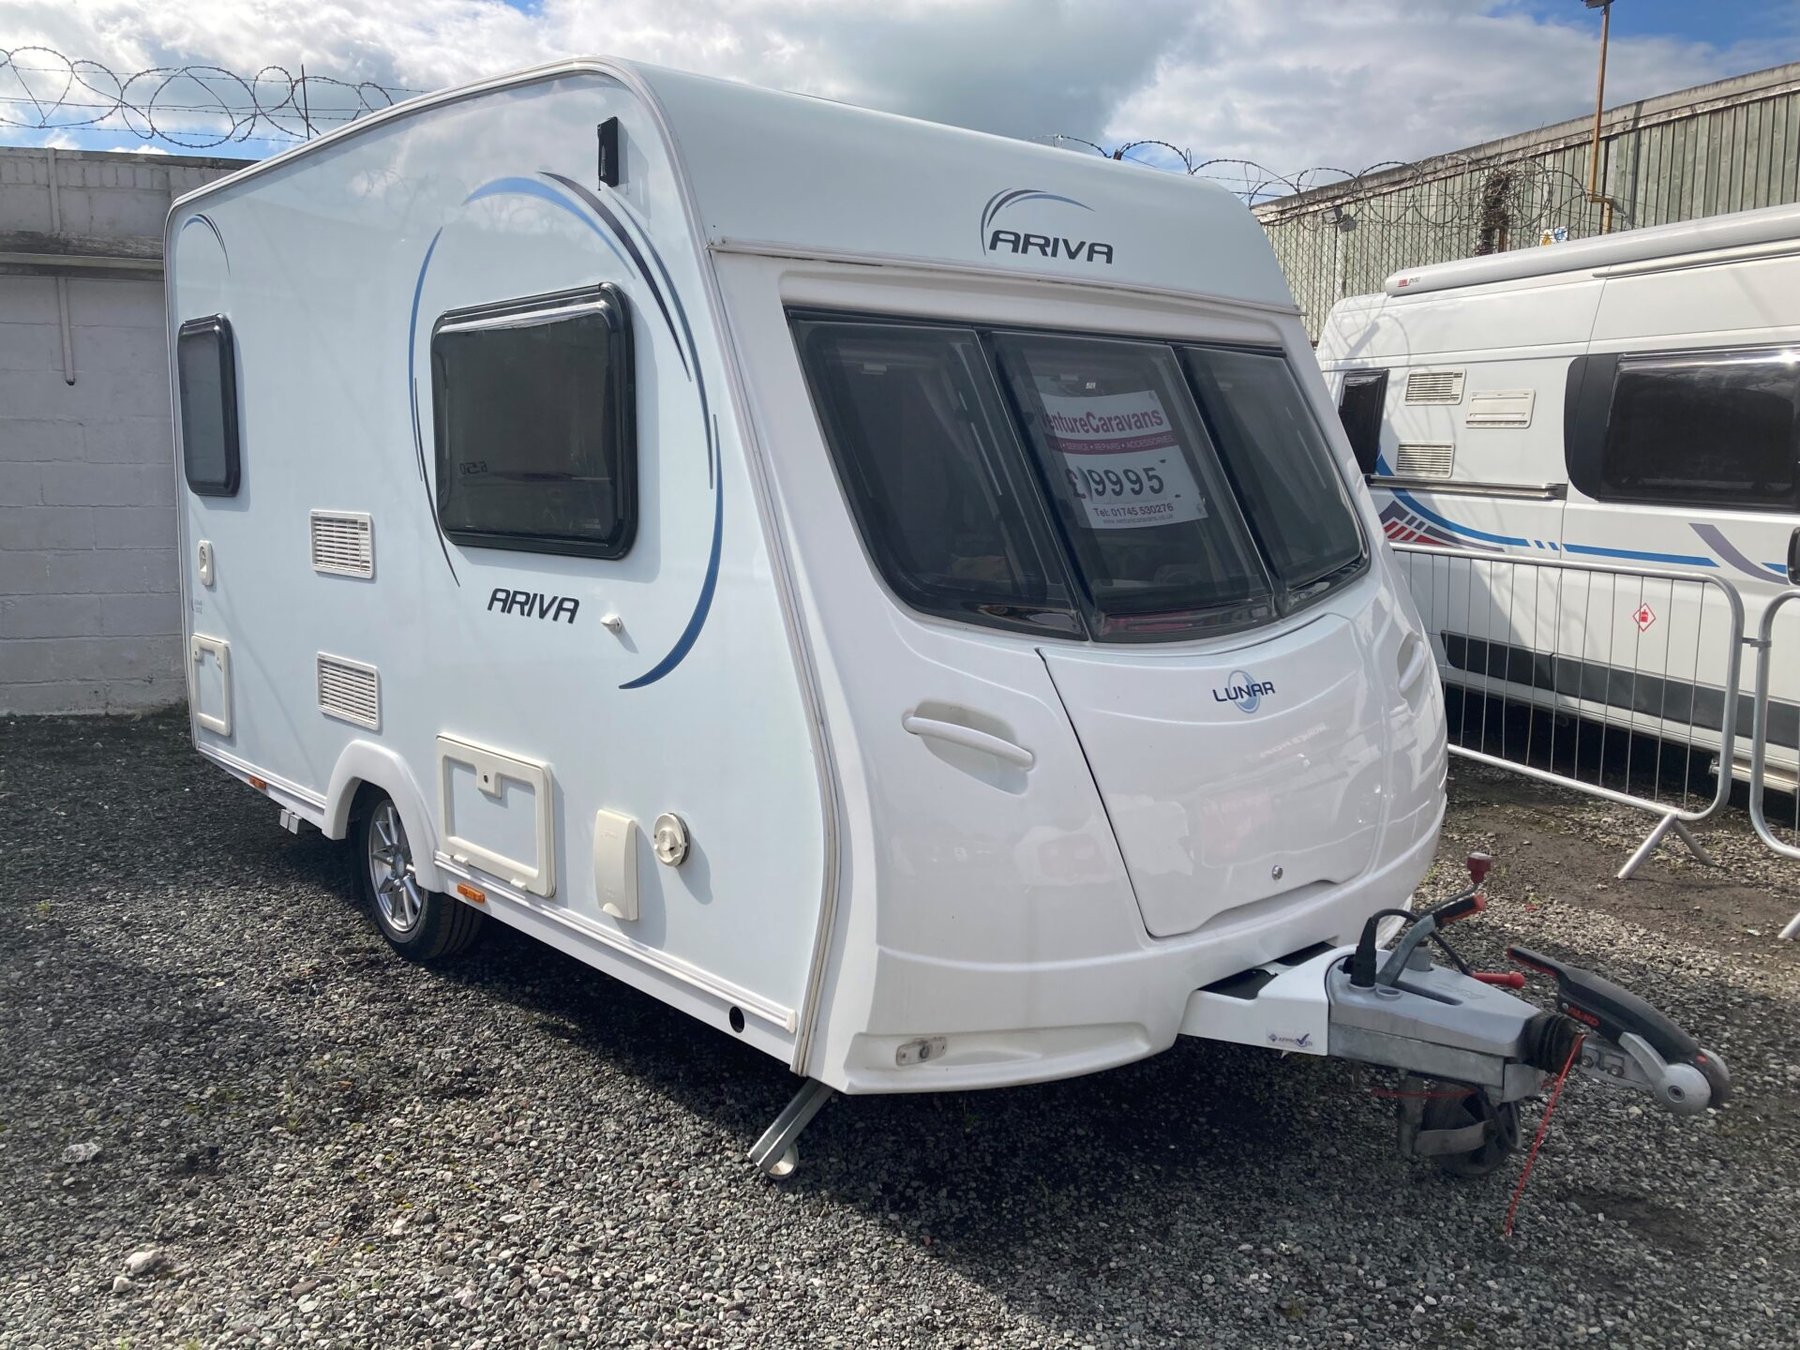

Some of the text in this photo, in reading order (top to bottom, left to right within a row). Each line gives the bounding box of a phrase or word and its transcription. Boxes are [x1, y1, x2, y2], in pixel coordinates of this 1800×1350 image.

[989, 230, 1113, 264] ARIVA
[1111, 506, 1138, 517] 01745
[1139, 503, 1174, 515] 530276
[487, 588, 580, 624] ARIVA
[1212, 681, 1276, 702] LUNAR
